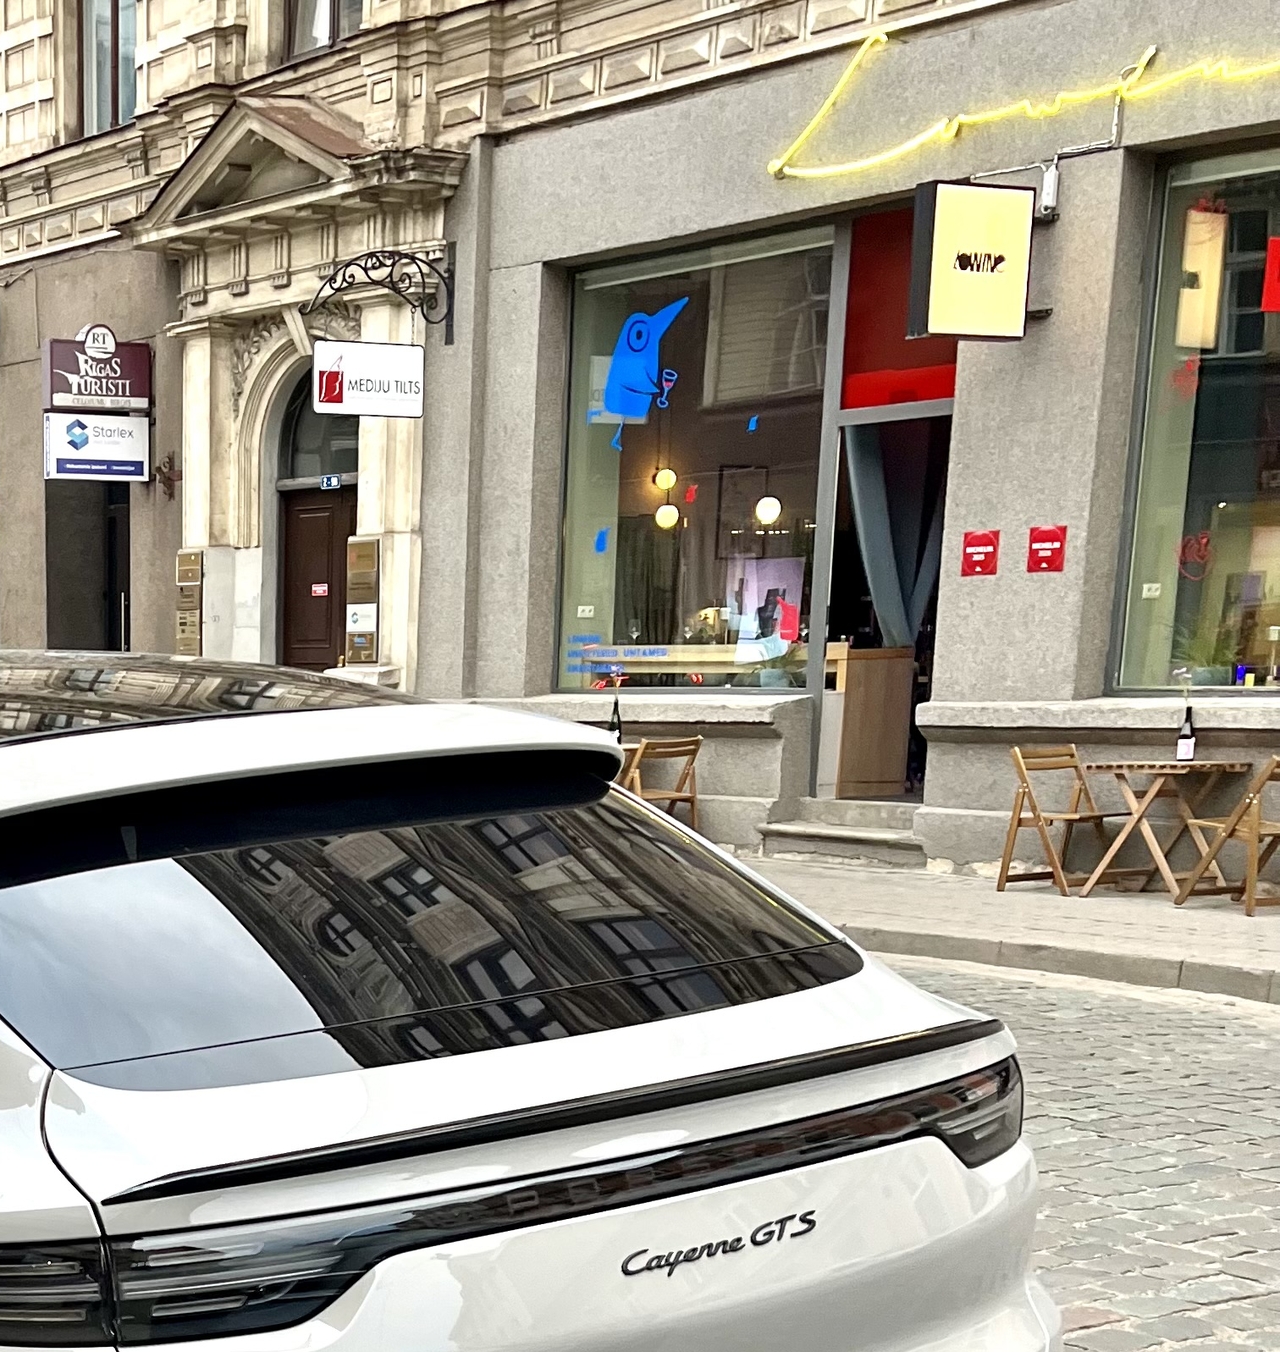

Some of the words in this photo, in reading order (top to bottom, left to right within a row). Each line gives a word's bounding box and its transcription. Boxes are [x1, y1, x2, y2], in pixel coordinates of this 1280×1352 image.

[92, 332, 108, 345] RT
[62, 373, 131, 396] TURISTI
[348, 379, 391, 394] MEDIJU
[395, 380, 421, 395] TILTS
[93, 426, 134, 440] Starlex
[621, 1237, 746, 1277] Cayenne
[750, 1209, 817, 1247] GTS
